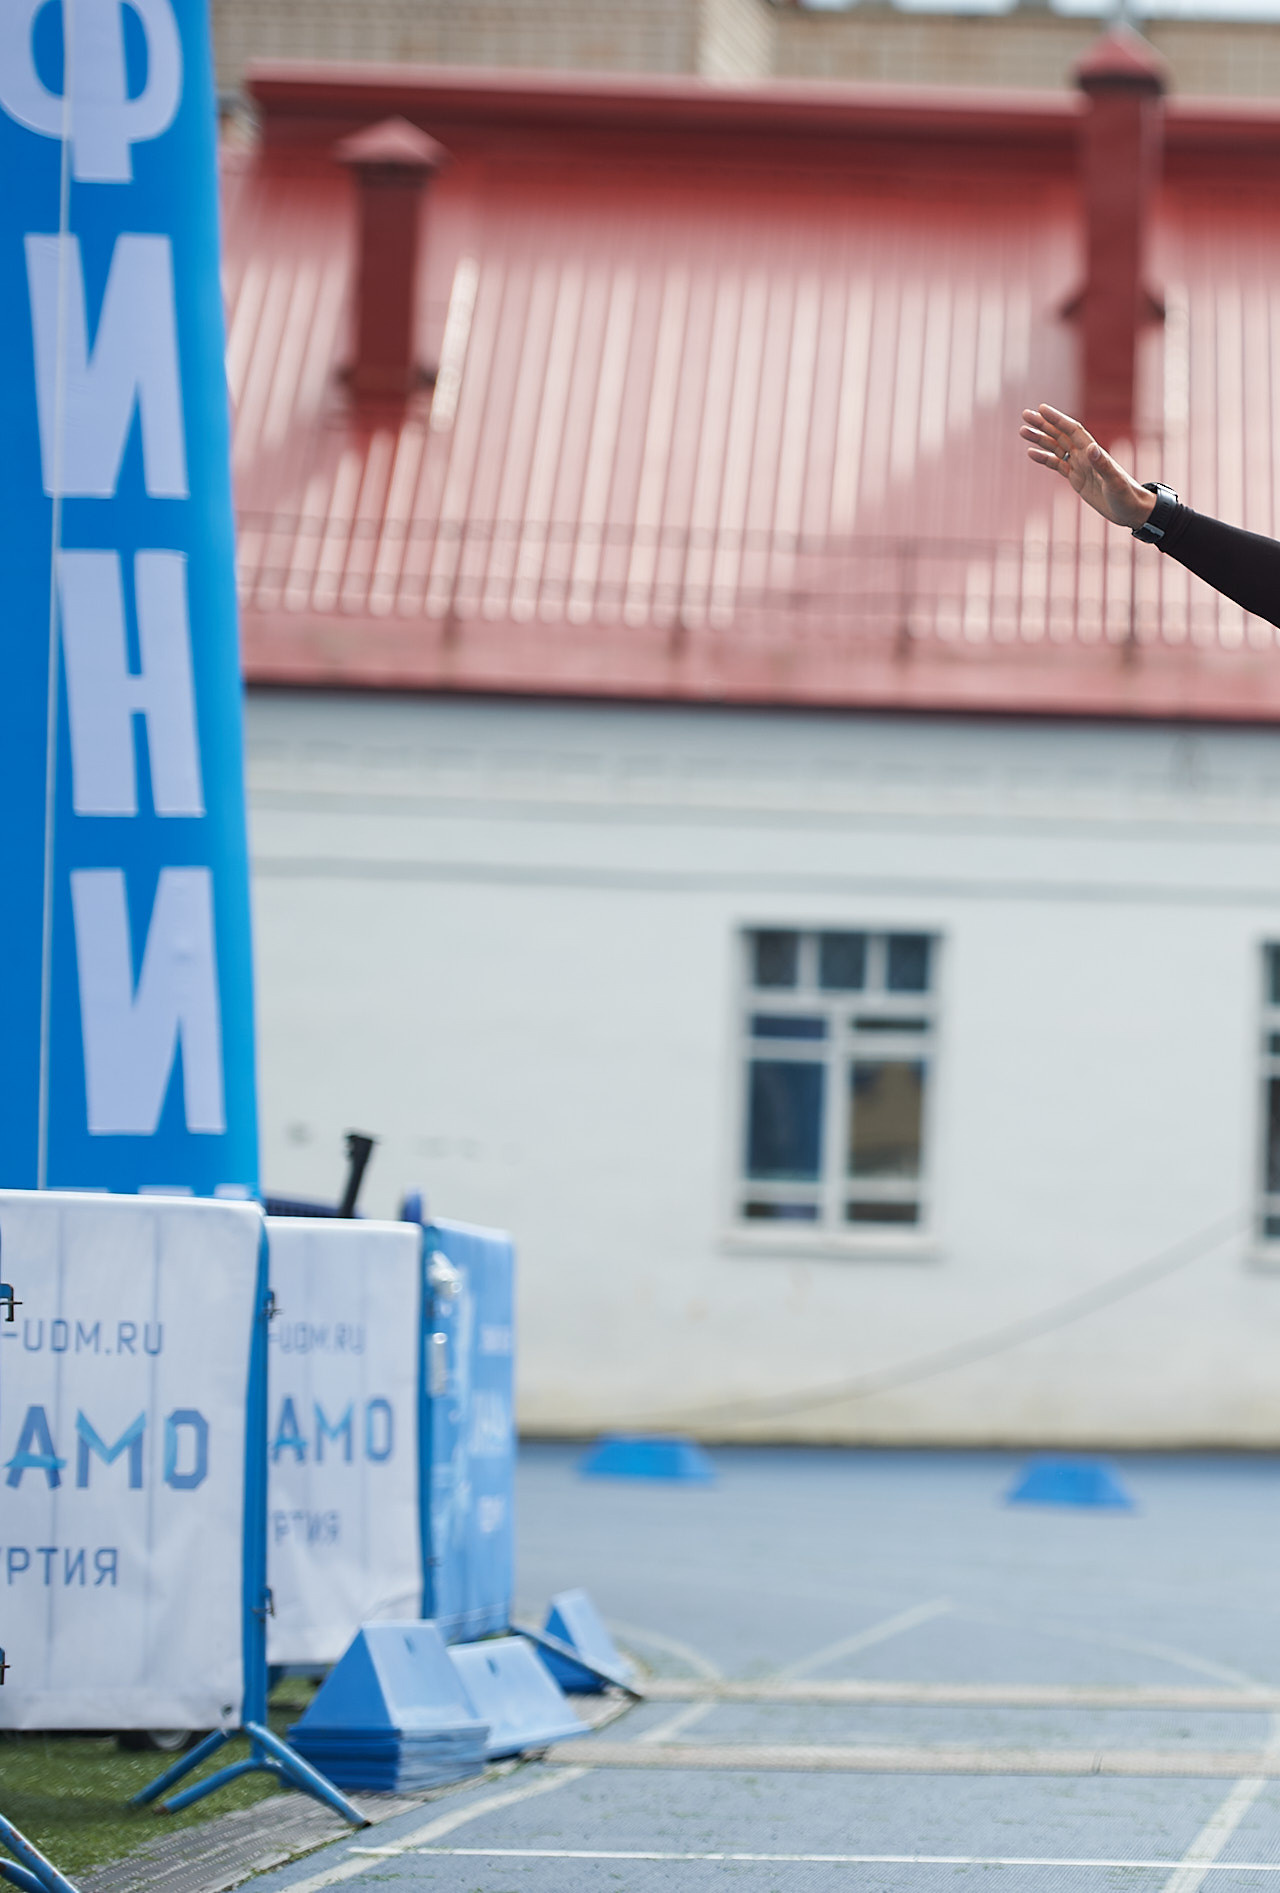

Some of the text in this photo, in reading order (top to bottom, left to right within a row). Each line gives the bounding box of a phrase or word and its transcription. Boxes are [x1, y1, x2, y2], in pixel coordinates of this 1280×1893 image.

[0, 0, 249, 1197] ФИНИ
[268, 1508, 342, 1547] РТИЯ
[0, 1546, 118, 1587] РТИЯ
